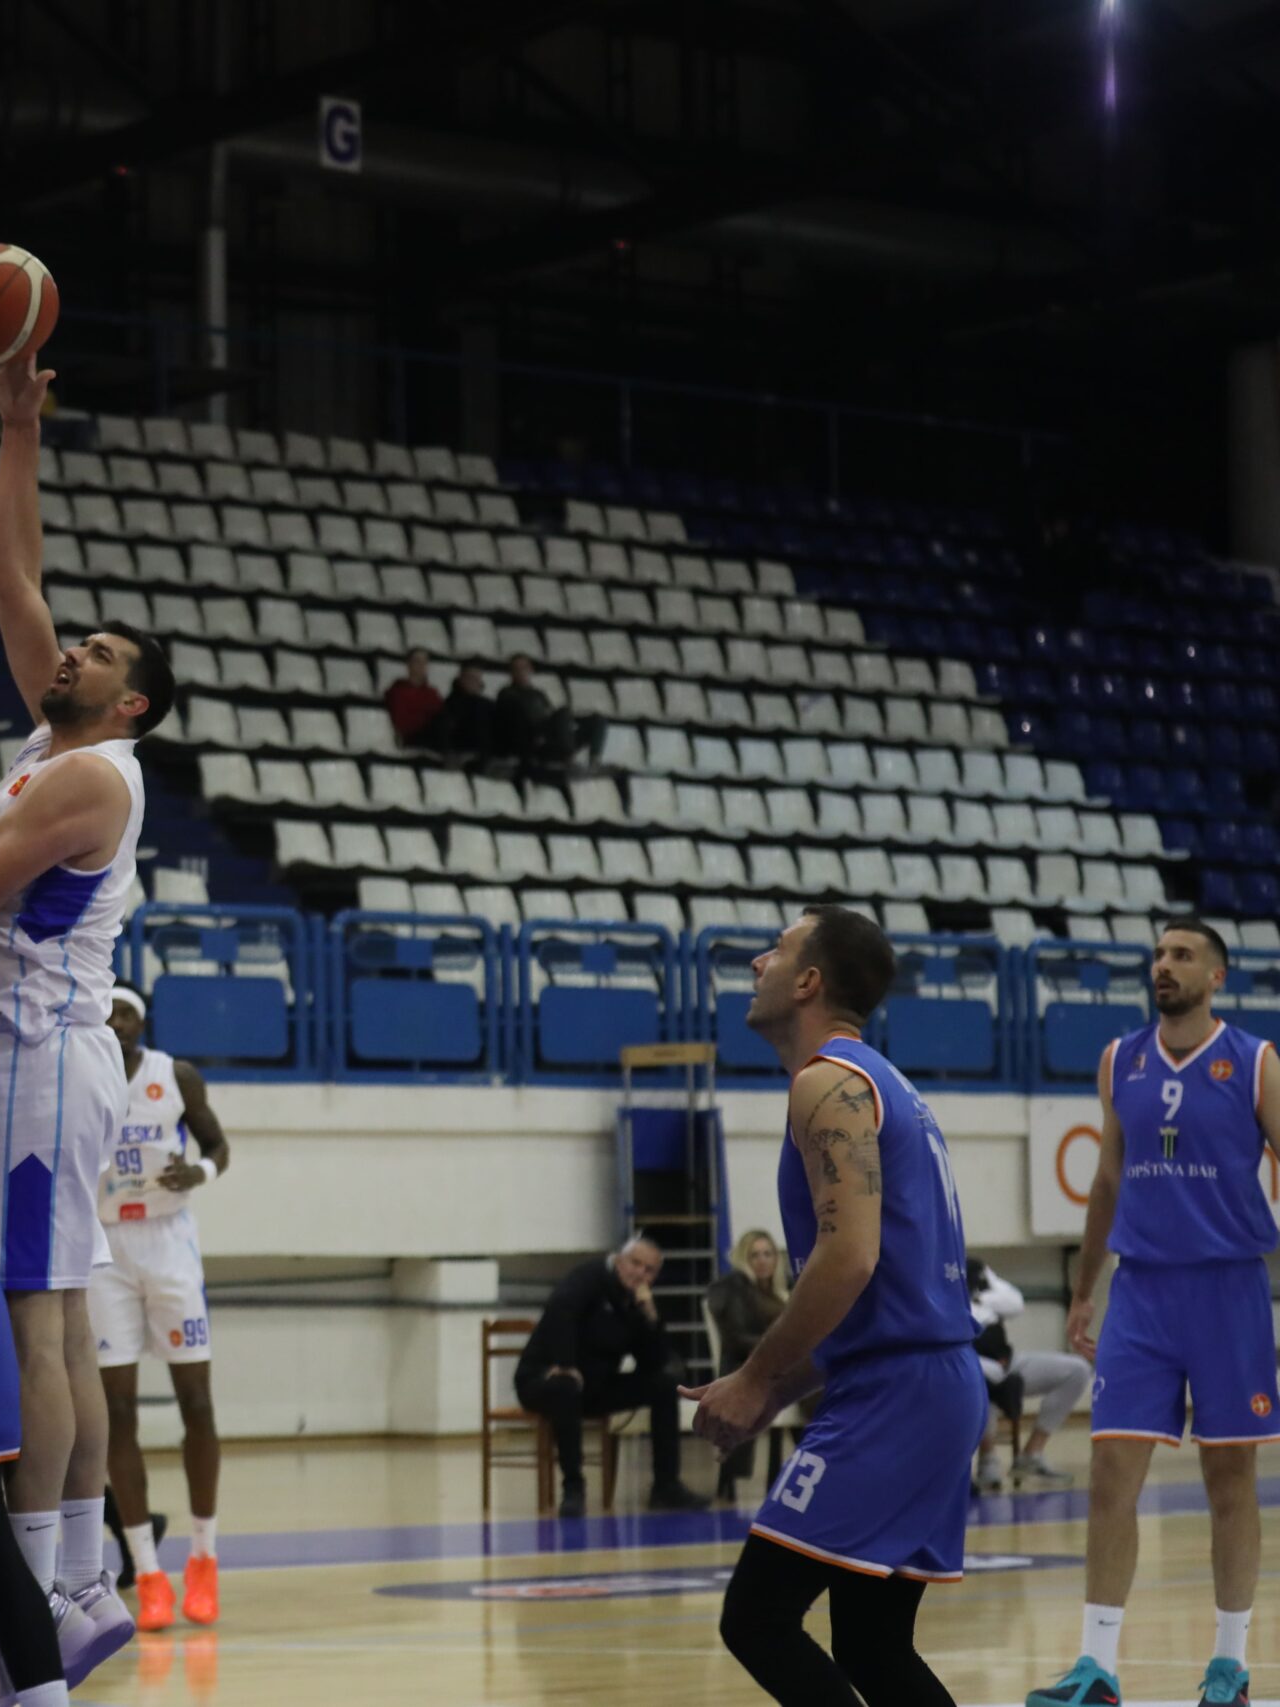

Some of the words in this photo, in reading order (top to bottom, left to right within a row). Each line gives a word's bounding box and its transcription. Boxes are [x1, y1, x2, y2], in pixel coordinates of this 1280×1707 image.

[325, 104, 359, 165] G
[1161, 1079, 1184, 1121] 9
[115, 1147, 143, 1176] 99
[1188, 1162, 1218, 1180] BAR
[182, 1317, 208, 1347] 99
[771, 1448, 827, 1514] 13
